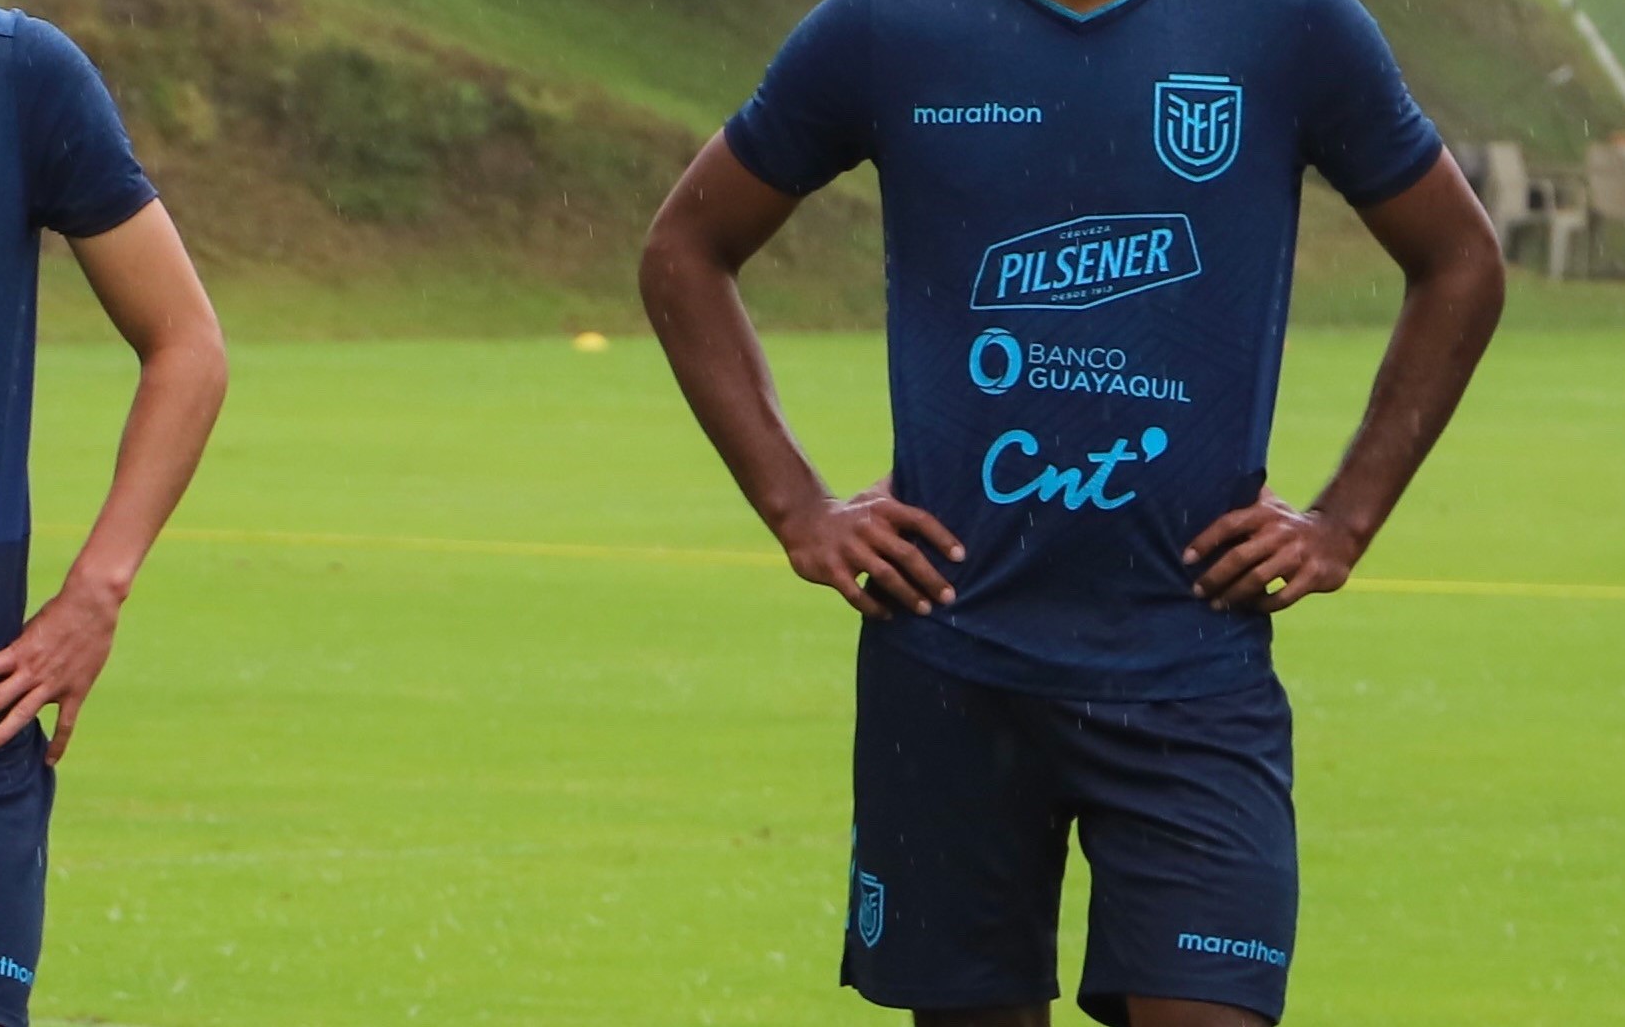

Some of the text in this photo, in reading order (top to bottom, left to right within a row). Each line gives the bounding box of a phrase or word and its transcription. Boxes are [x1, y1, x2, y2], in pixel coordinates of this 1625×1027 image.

[914, 102, 1042, 124] marathon
[996, 228, 1174, 299] PILSENER
[1028, 343, 1126, 370] BANCO
[1028, 367, 1191, 403] GUAYAQUIL
